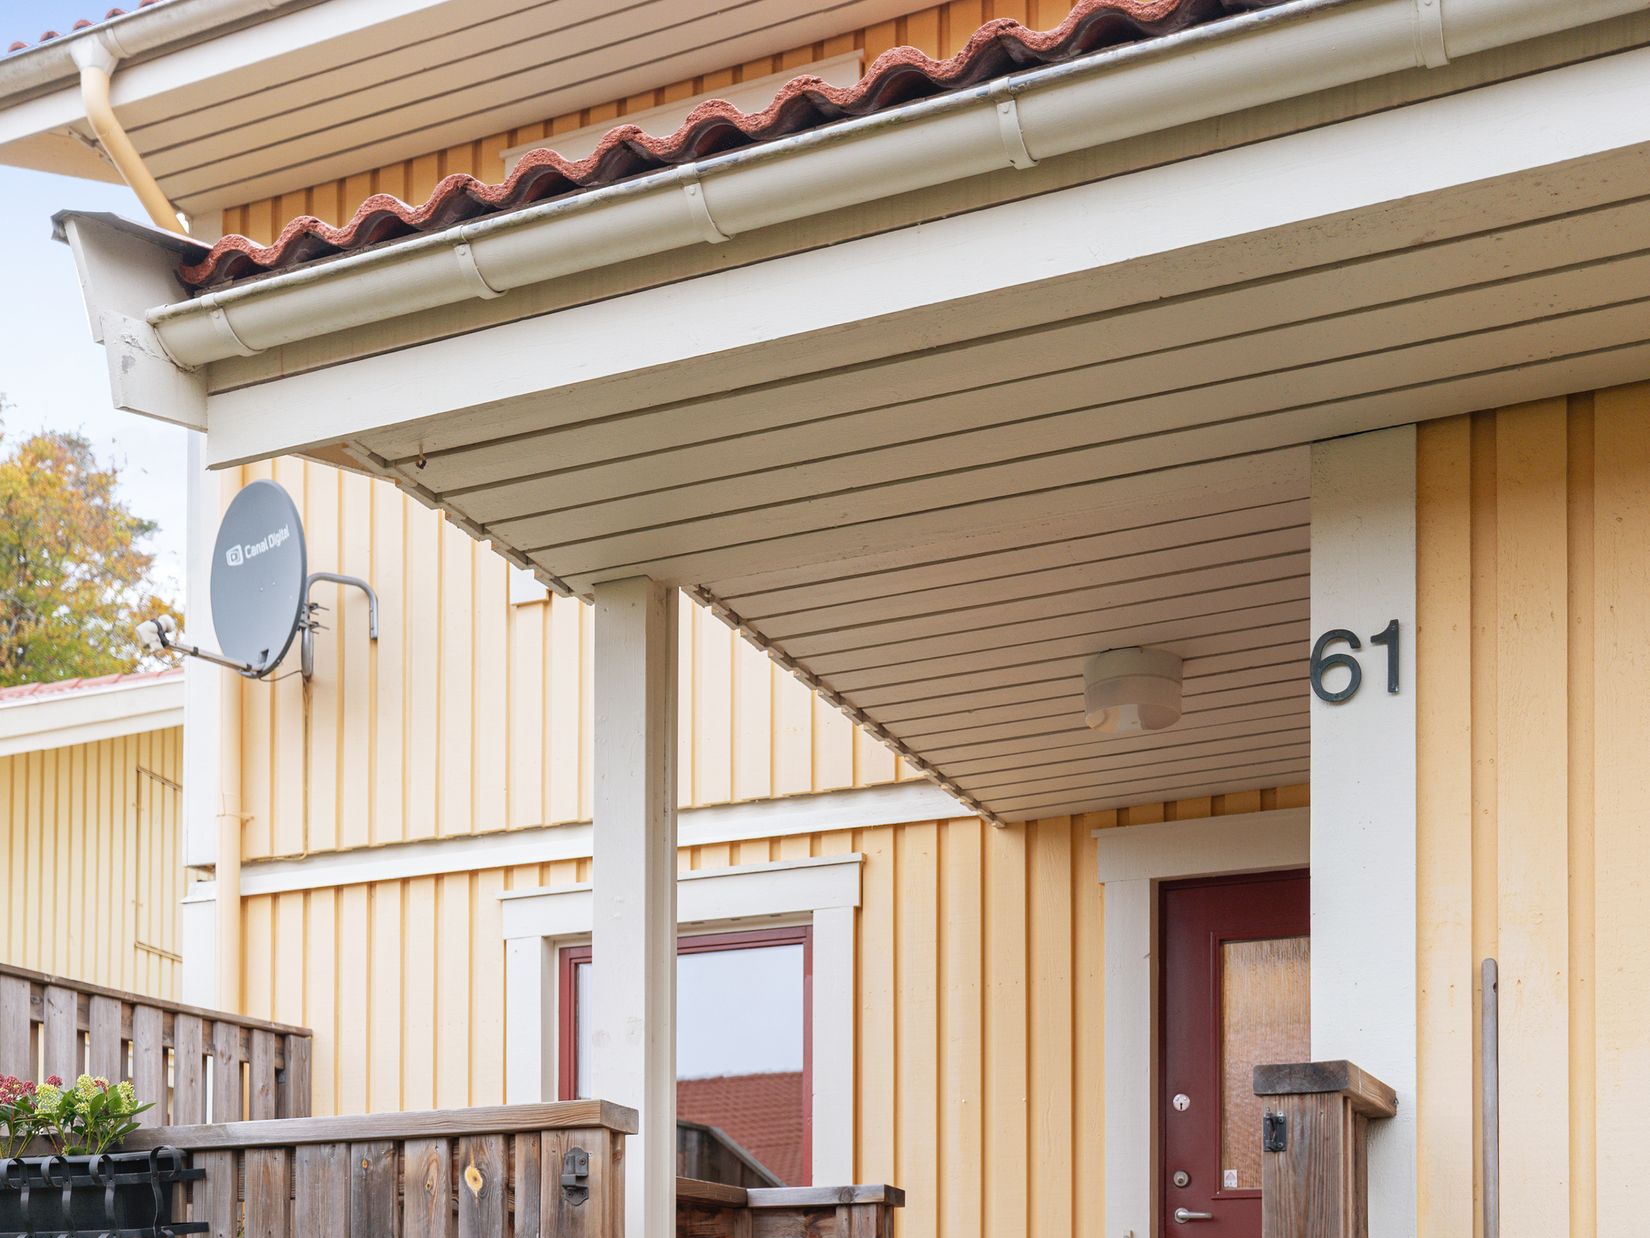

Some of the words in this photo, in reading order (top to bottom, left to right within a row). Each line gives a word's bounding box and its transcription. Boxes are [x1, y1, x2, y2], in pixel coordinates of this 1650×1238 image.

[244, 537, 269, 559] Canal
[267, 523, 290, 548] Digital
[1310, 619, 1400, 702] 61
